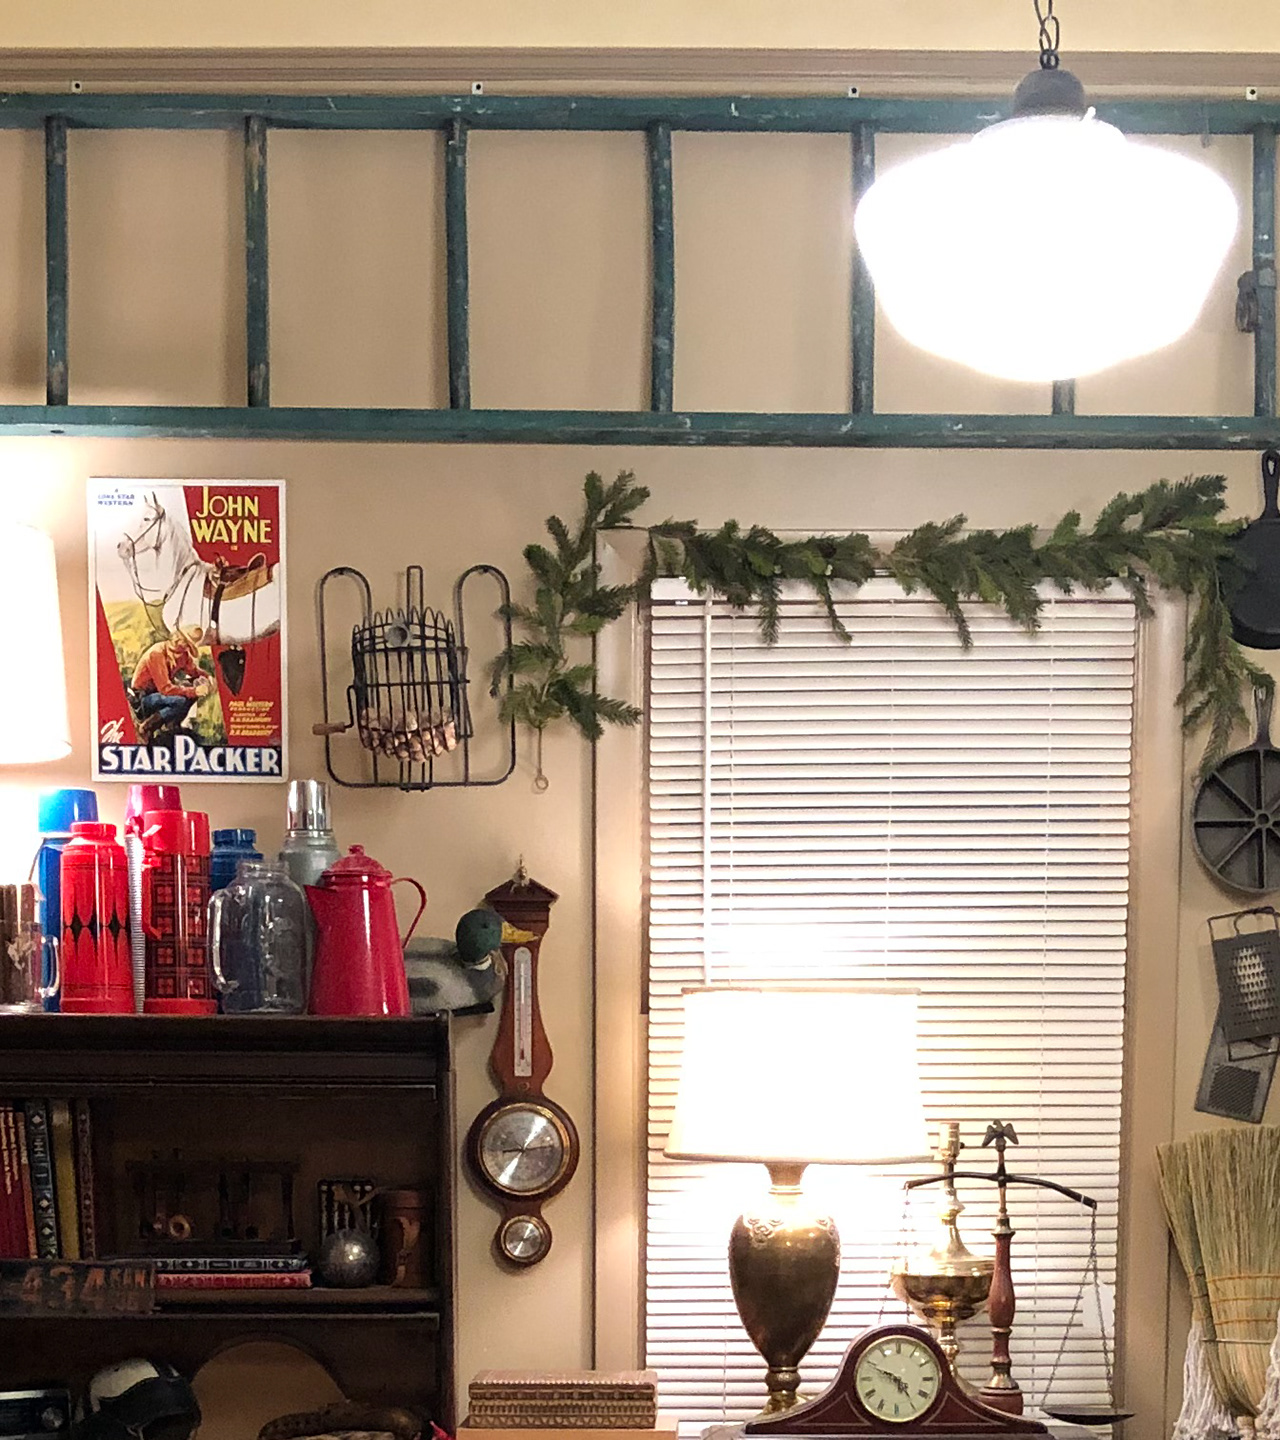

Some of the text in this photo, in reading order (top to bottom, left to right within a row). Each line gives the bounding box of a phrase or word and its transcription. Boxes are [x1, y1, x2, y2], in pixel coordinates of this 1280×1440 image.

[195, 486, 259, 518] JOHN
[191, 519, 272, 543] WAYNE
[100, 716, 125, 744] The
[101, 735, 280, 774] STAR PACKER
